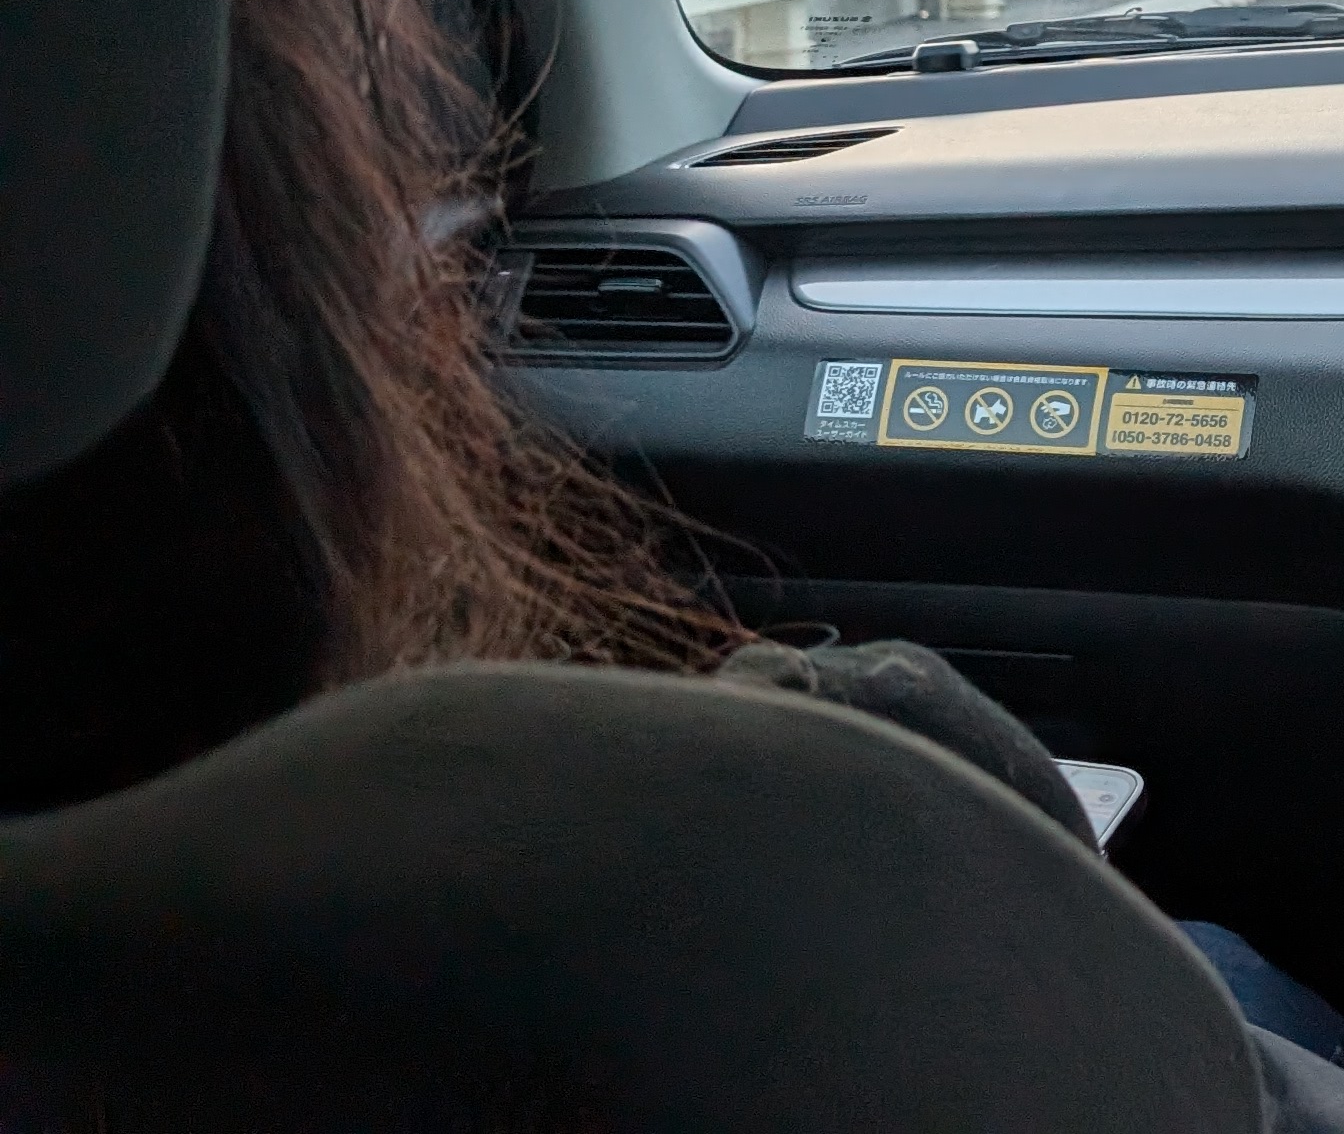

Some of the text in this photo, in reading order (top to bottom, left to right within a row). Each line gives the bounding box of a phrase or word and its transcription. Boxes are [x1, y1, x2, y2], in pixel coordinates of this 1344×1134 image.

[1146, 378, 1237, 392] 事故時の緊急連絡先
[1122, 411, 1228, 428] 0120-72-5656
